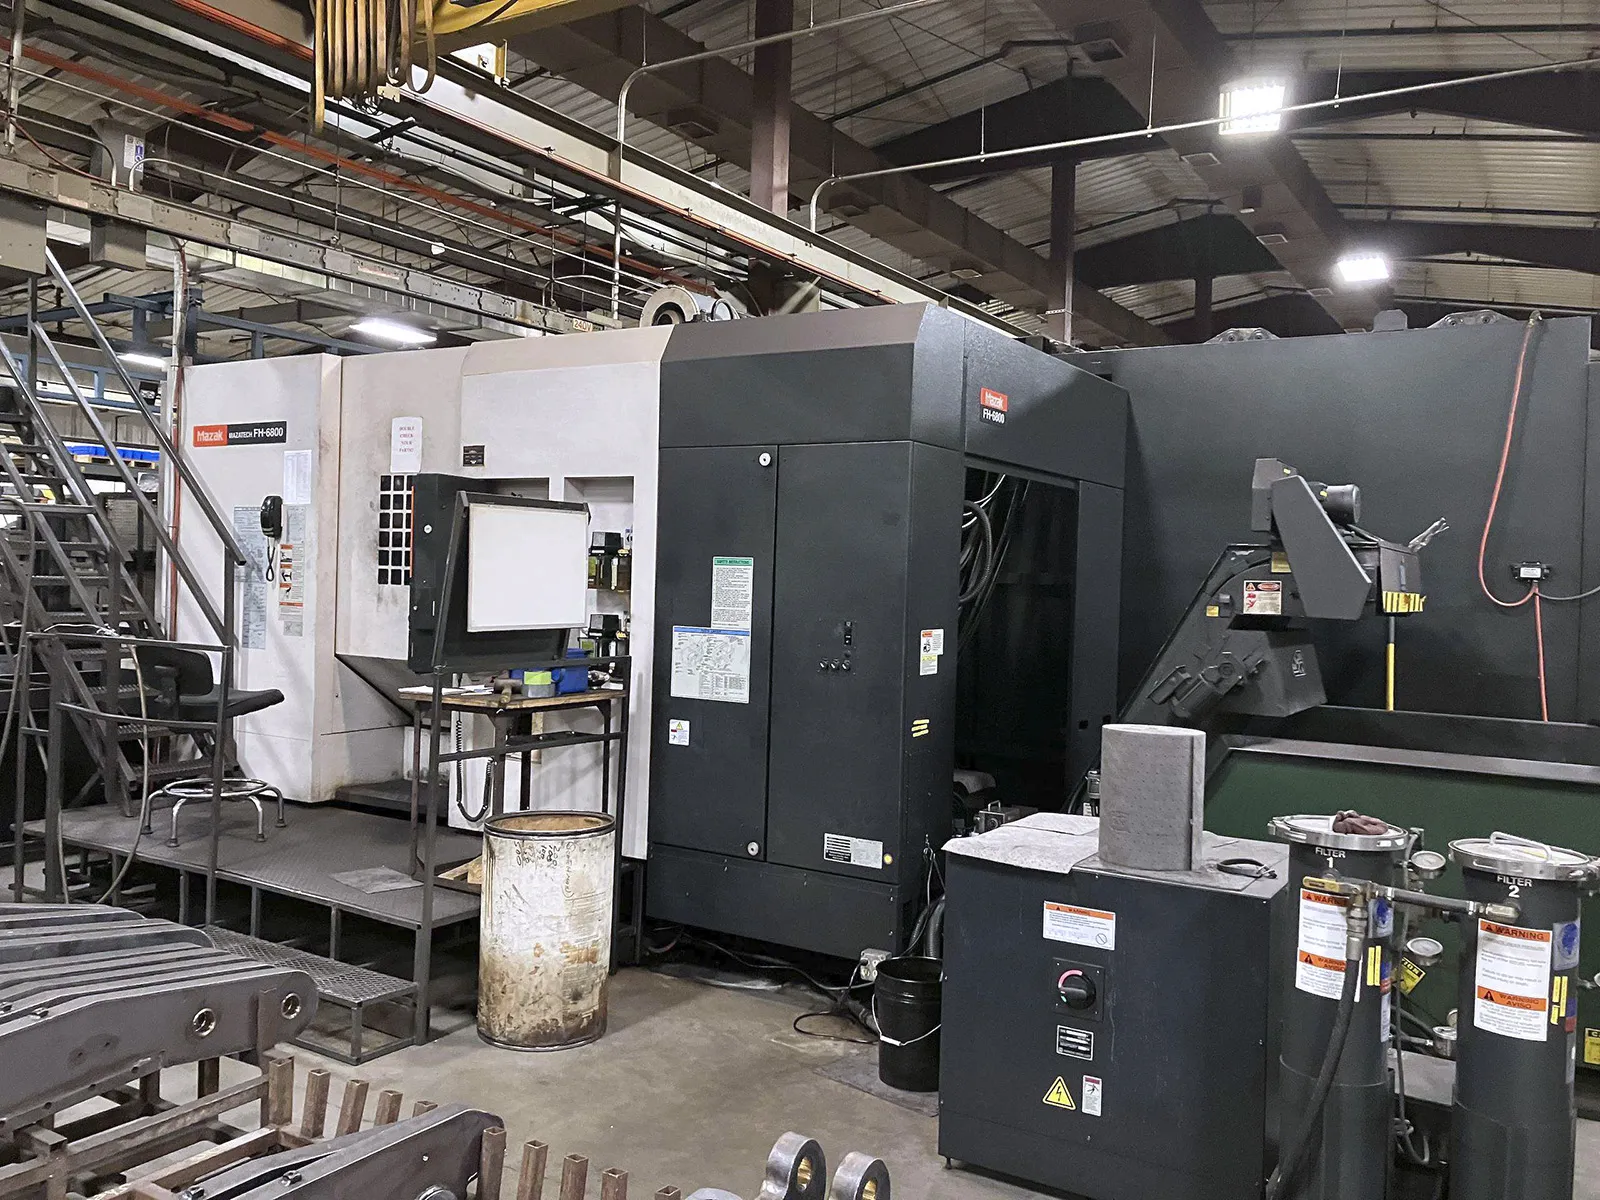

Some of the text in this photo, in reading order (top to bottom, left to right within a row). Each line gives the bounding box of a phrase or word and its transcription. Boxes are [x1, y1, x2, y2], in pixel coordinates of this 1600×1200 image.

[574, 319, 592, 331] 240V
[982, 408, 1005, 424] FH-6800
[196, 430, 223, 442] Mazak
[253, 427, 284, 438] FH-6800
[1315, 847, 1346, 858] FILTER
[1326, 857, 1334, 868] 1
[1497, 875, 1532, 887] FILTER
[1508, 885, 1520, 898] 2
[1495, 926, 1544, 941] WARNING
[1499, 993, 1539, 1004] WARNING
[1506, 1000, 1532, 1009] AVISO
